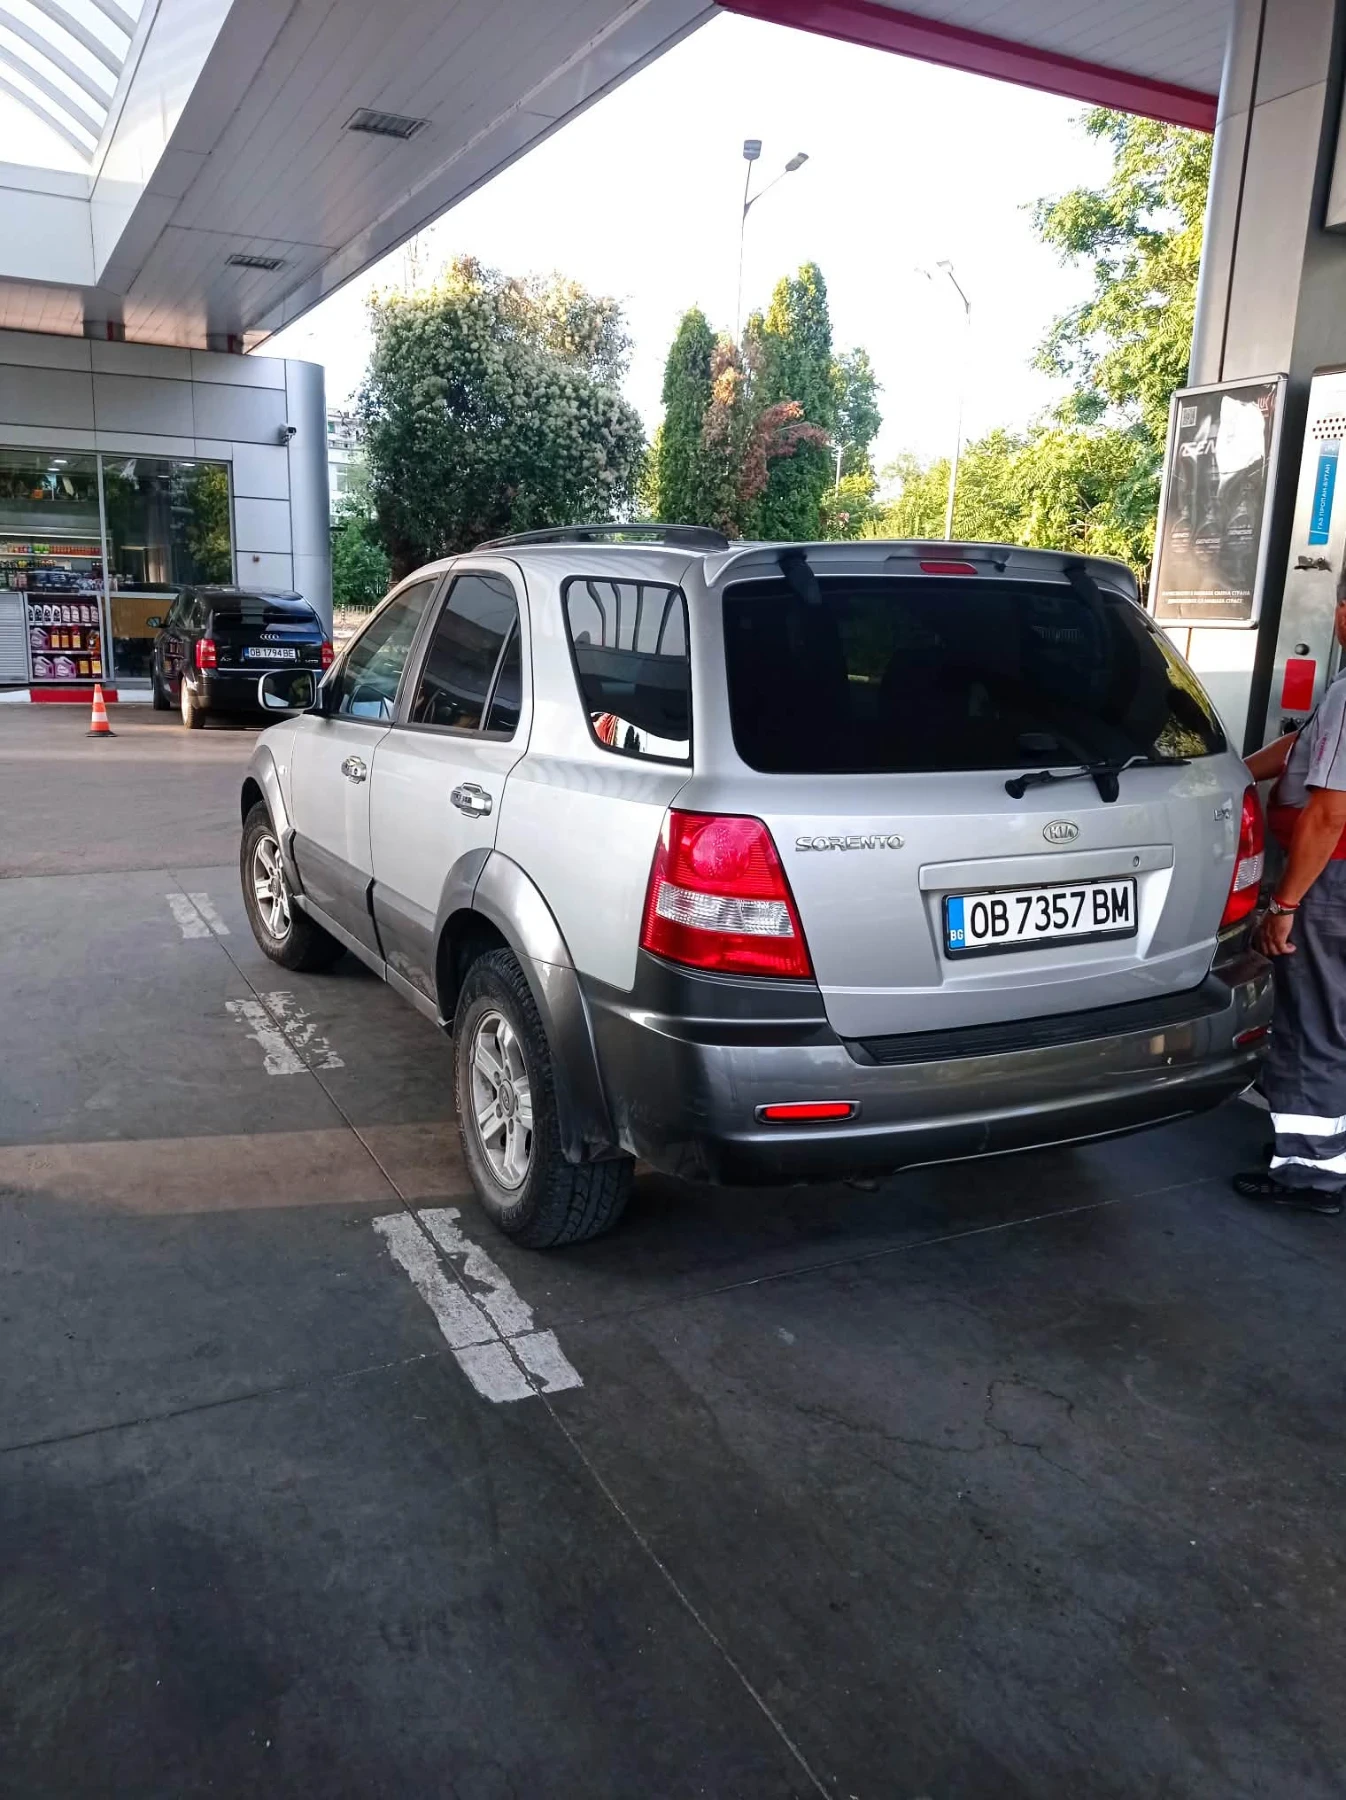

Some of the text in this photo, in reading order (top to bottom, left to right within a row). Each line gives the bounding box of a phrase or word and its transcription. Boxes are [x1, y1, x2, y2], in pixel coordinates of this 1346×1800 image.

[263, 648, 282, 657] 1794
[1046, 822, 1075, 839] KIA
[795, 833, 905, 852] SORENTO
[949, 886, 1129, 941] BG OB 7357 BM
